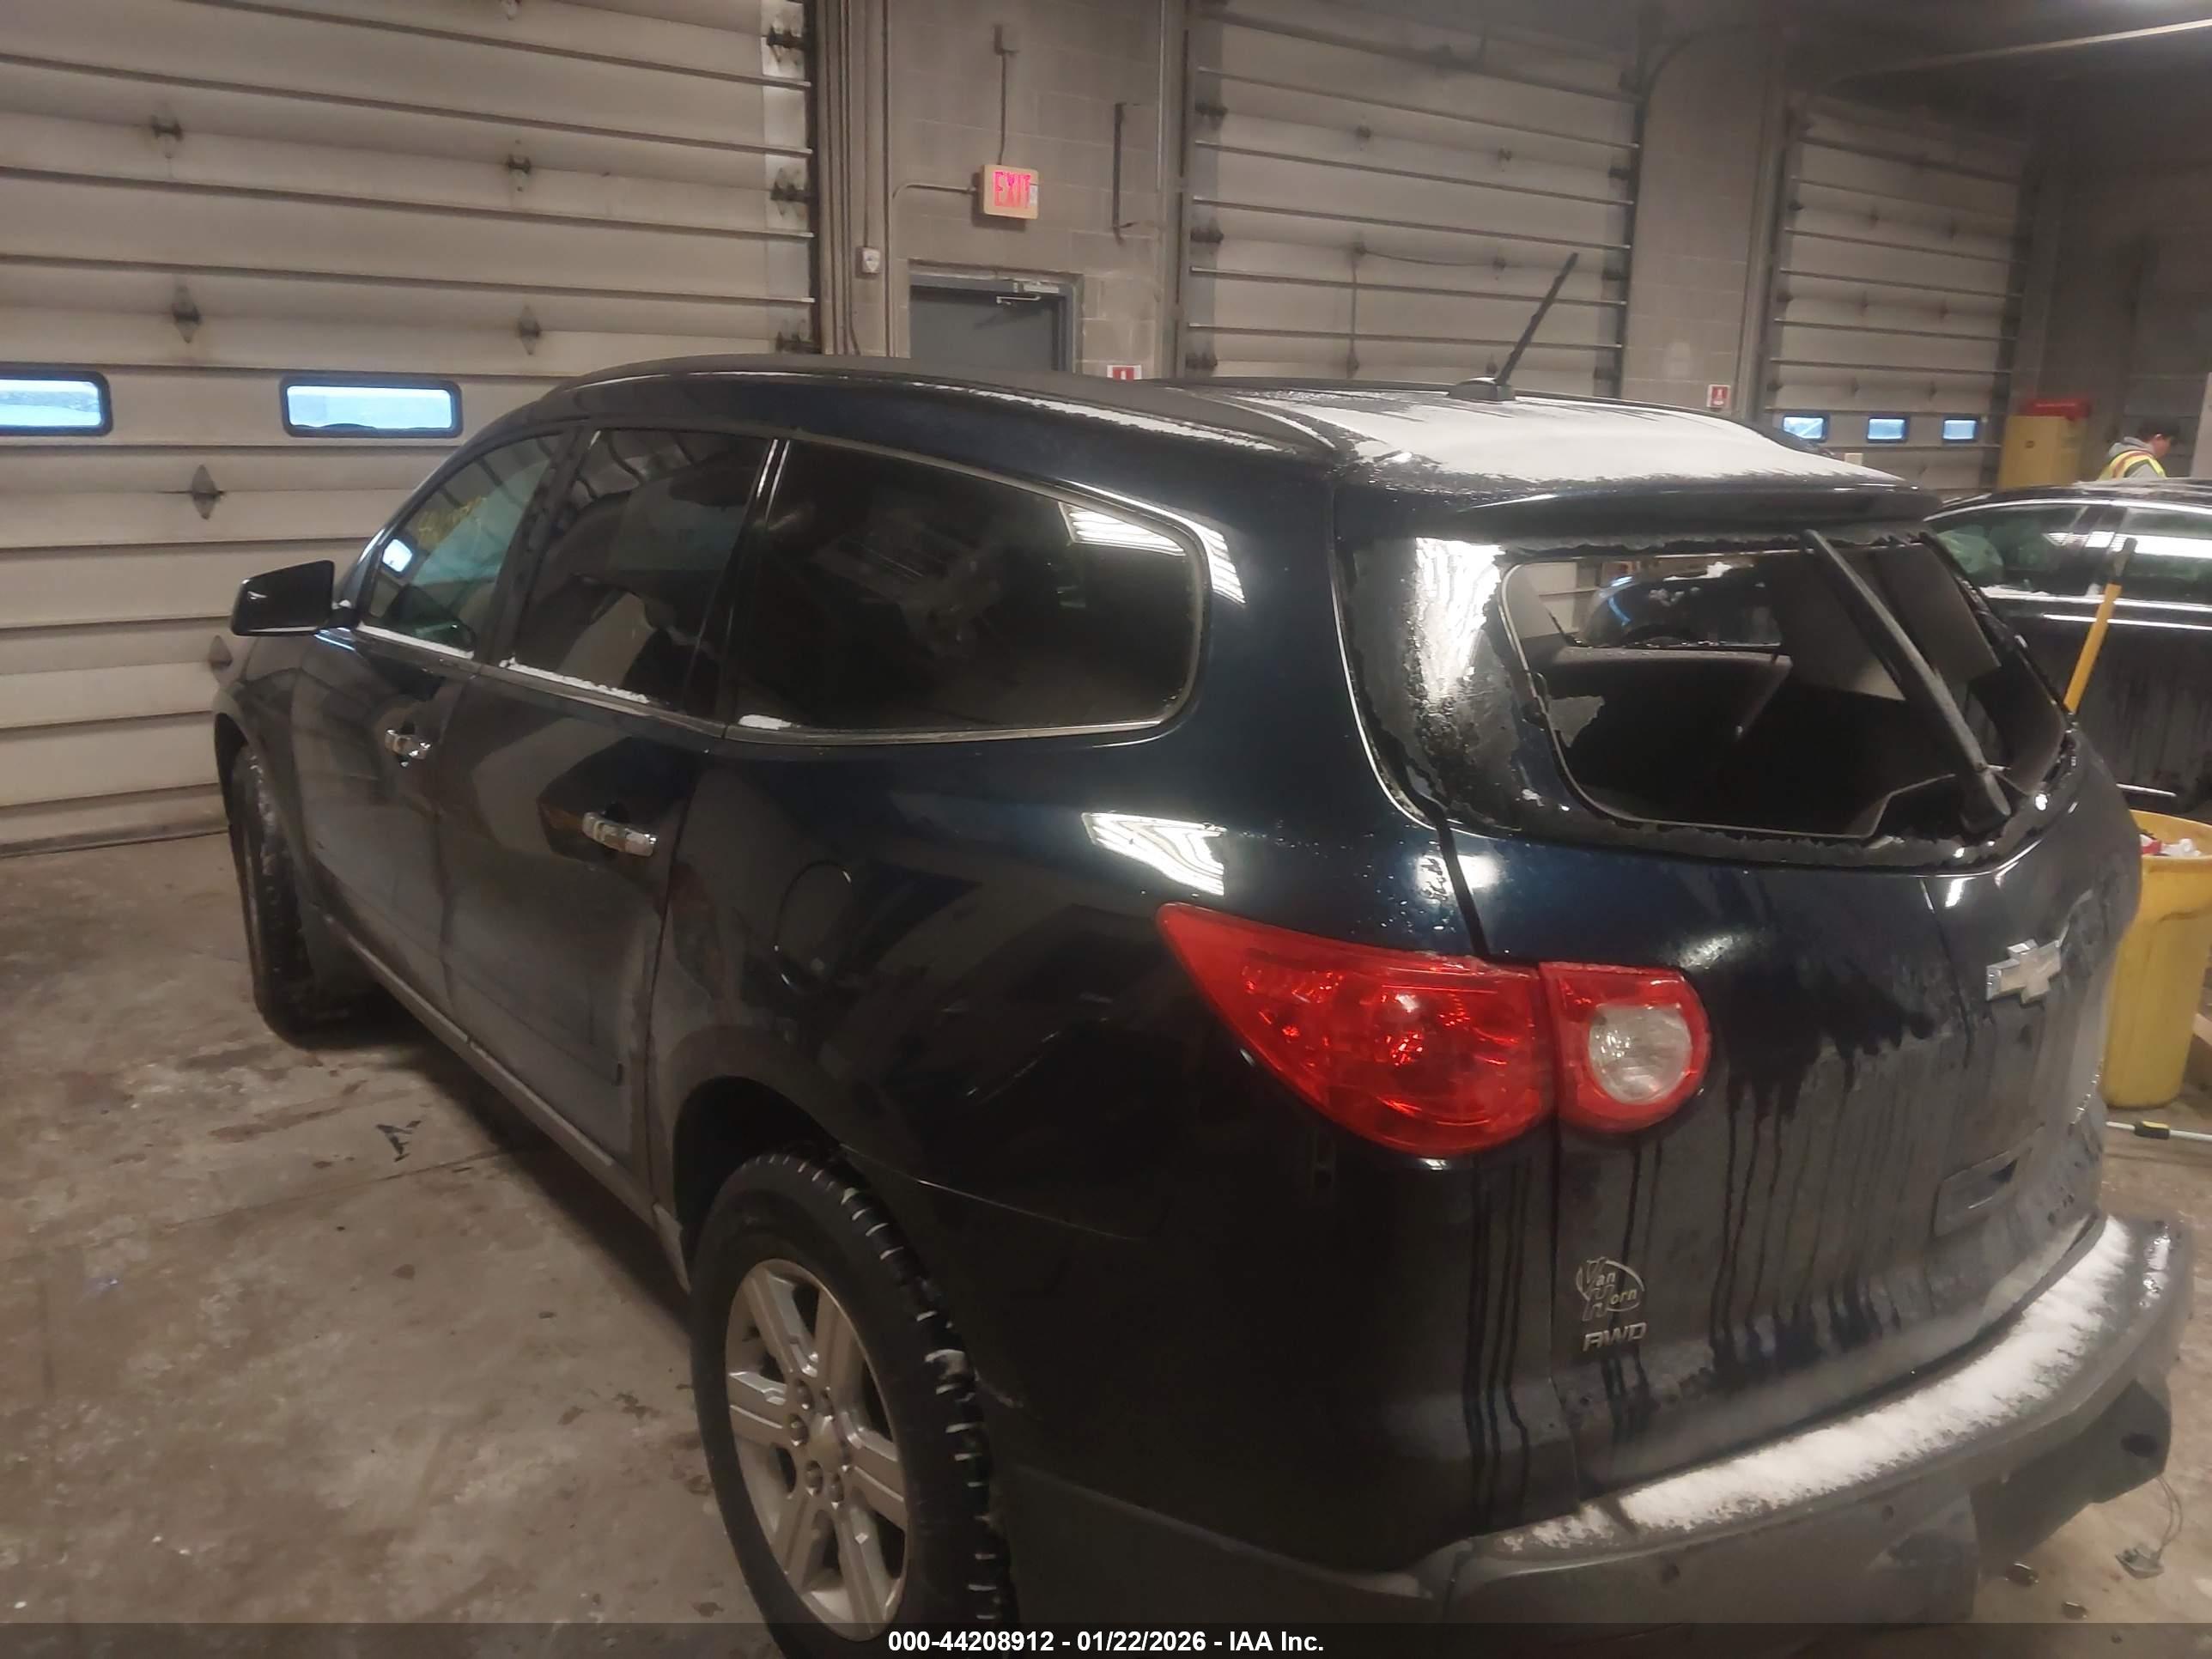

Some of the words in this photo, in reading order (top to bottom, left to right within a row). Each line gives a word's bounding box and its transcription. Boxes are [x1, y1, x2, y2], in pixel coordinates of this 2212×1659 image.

[994, 171, 1031, 208] EXIT
[1586, 1256, 1616, 1292] Van
[1582, 1285, 1638, 1322] Horn
[1583, 1322, 1647, 1352] AWD
